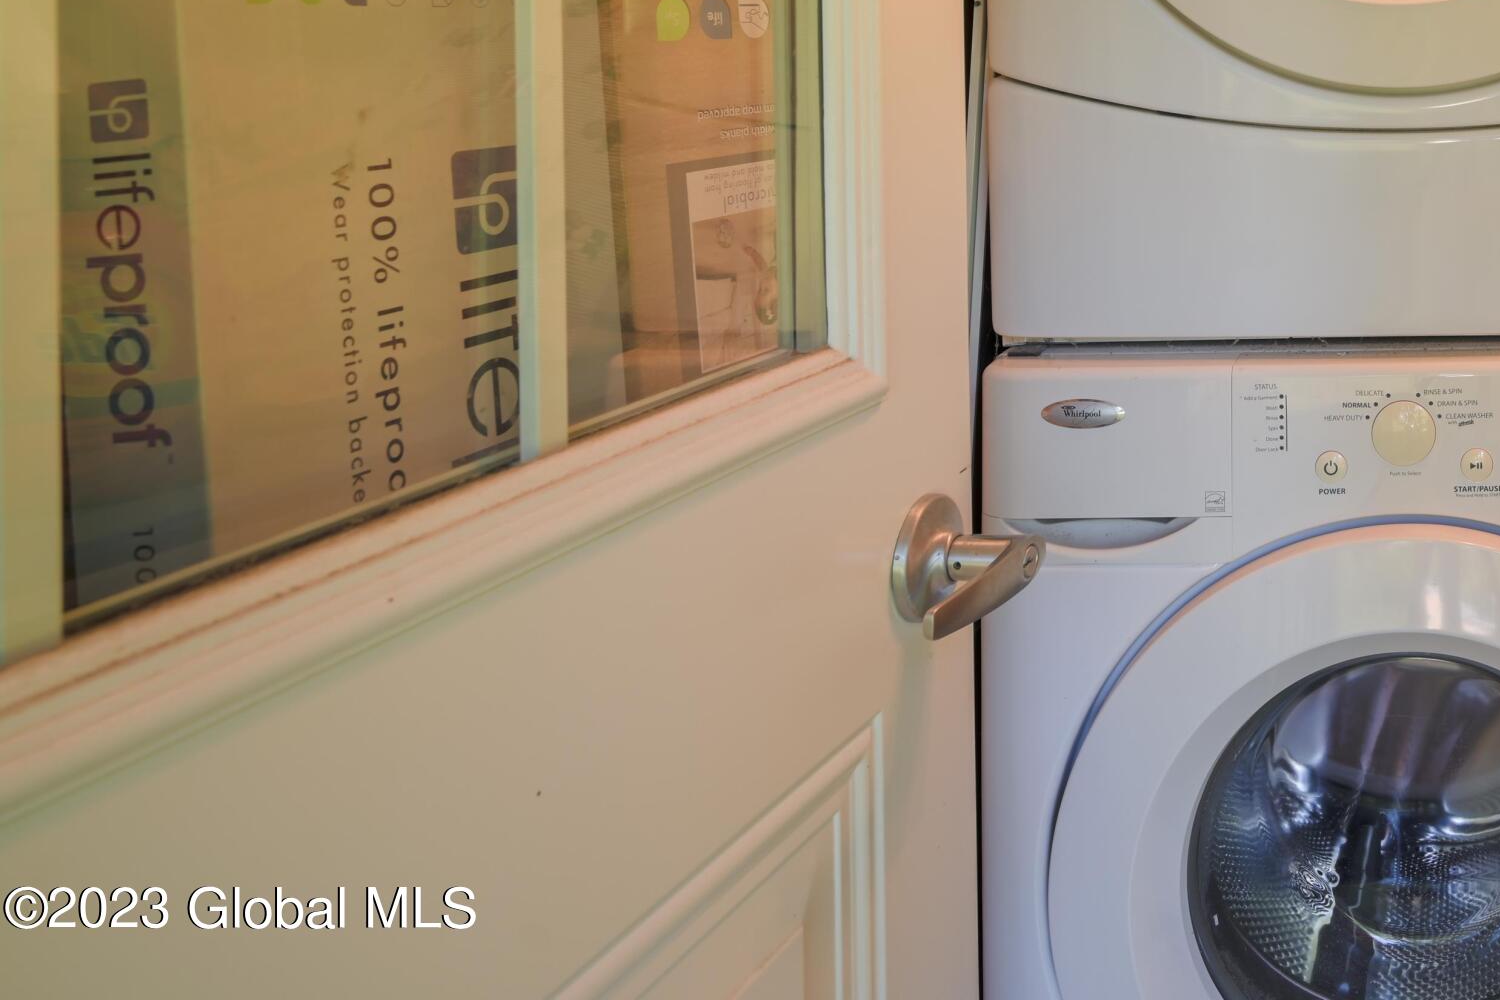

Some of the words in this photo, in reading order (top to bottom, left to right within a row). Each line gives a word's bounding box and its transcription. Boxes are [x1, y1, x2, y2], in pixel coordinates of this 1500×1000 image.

[328, 163, 351, 243] Wear
[366, 157, 400, 285] 100%
[86, 152, 173, 448] lifeproof
[331, 256, 363, 405] protection
[1254, 383, 1278, 391] STATUS
[1355, 389, 1384, 397] DELICATE
[1423, 388, 1440, 396] RINSE
[1448, 387, 1463, 395] SPIN
[1342, 401, 1372, 409] NORMAL
[1437, 399, 1457, 407] DRAIN
[1063, 409, 1102, 421] Whirlpool
[1323, 414, 1345, 422] HEAVY
[1446, 412, 1466, 420] CLEAN
[1467, 412, 1494, 420] WASHER
[1318, 487, 1346, 495] POWER
